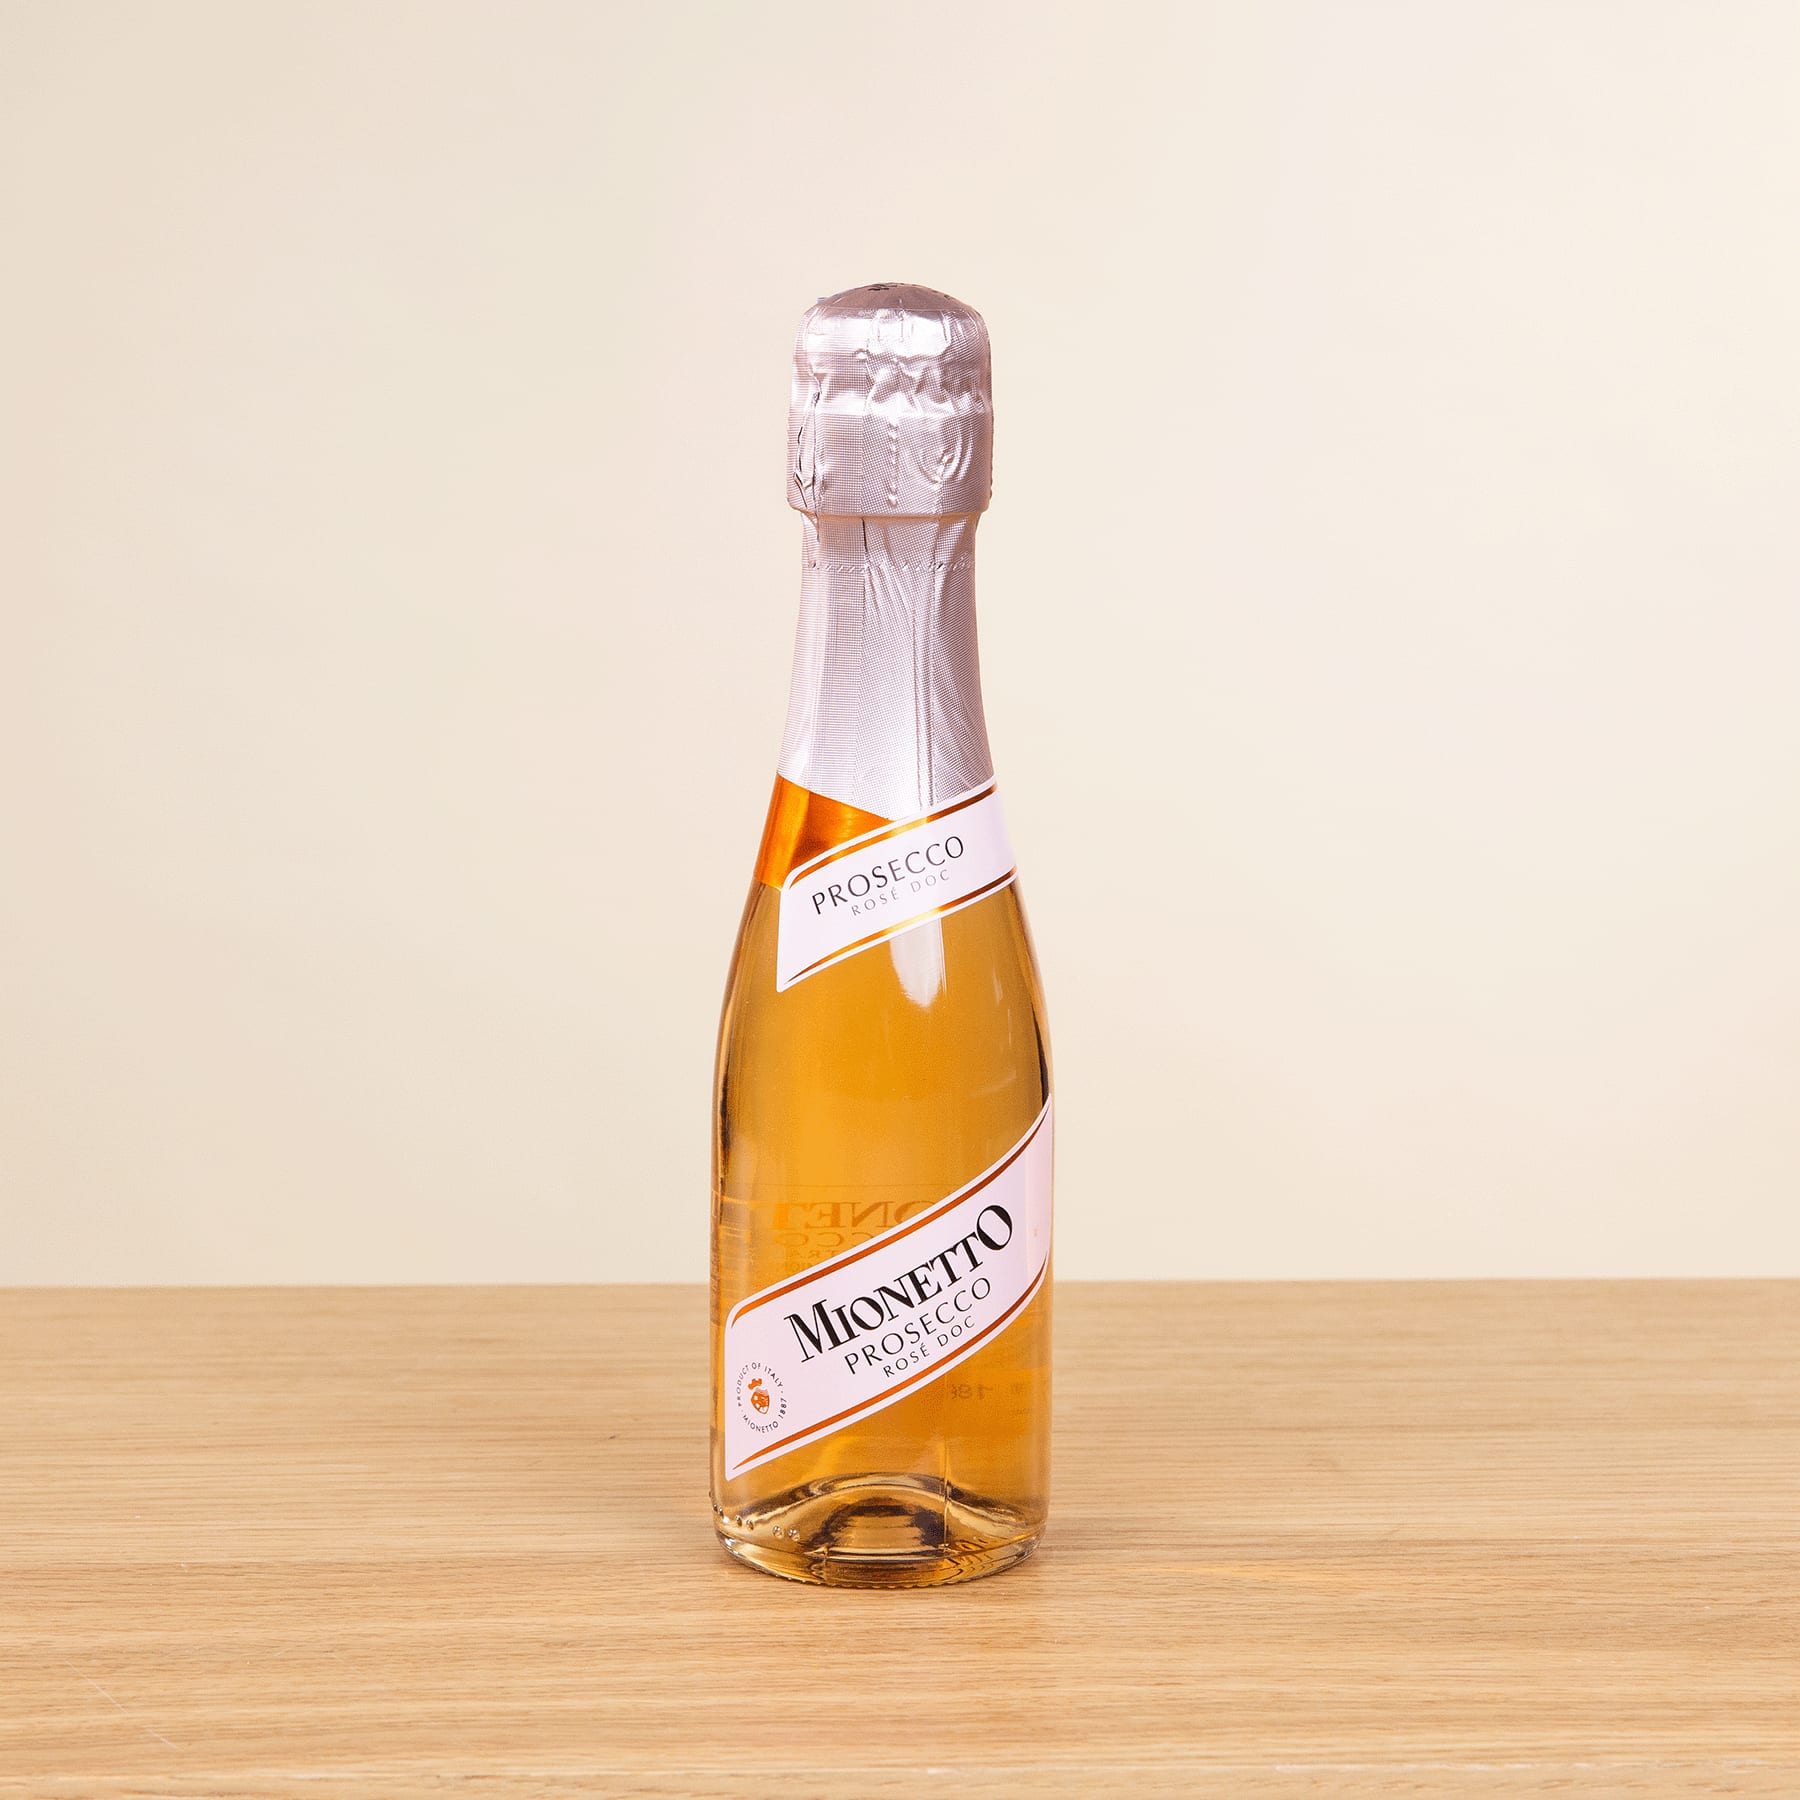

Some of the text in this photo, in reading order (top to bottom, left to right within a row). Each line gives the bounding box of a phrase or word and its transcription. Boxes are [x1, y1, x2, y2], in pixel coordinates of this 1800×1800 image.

[811, 836, 965, 915] PROSECCO
[851, 869, 951, 917] ROSÉ DOC
[783, 1204, 1013, 1363] MIONETTO
[844, 1277, 991, 1375] PROSECCO
[882, 1314, 976, 1378] ROSÉ DOC
[736, 1362, 784, 1407] PRODUCT OF ITALY
[742, 1398, 788, 1434] MIONETTO 1887
